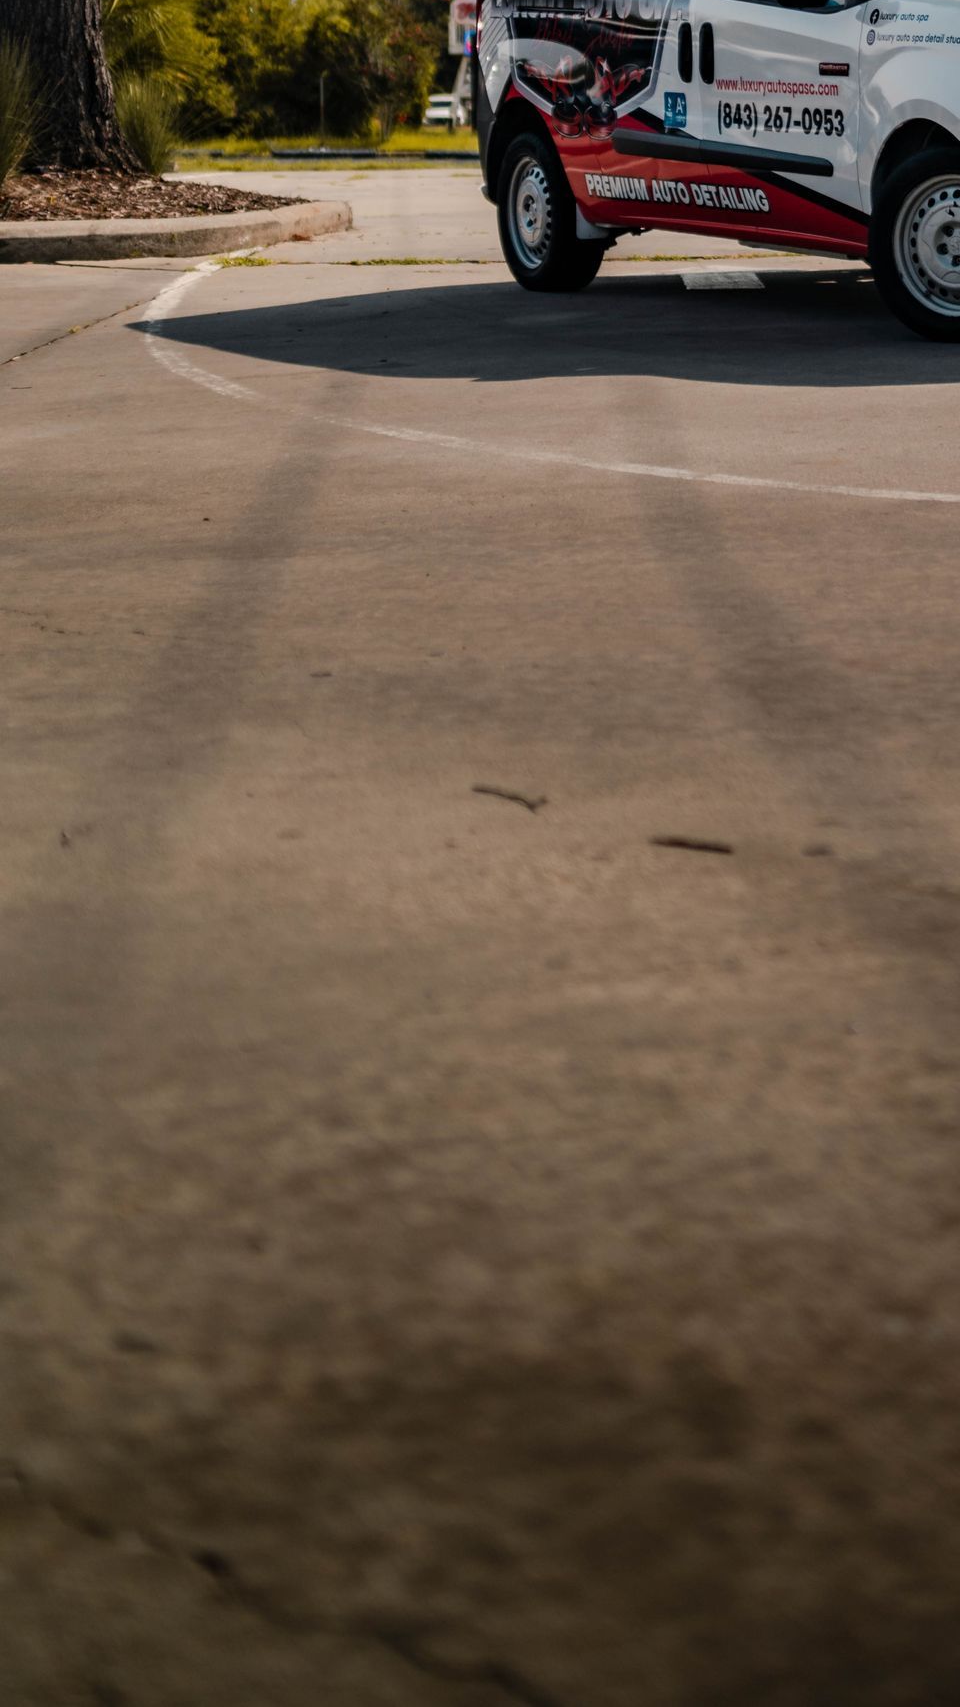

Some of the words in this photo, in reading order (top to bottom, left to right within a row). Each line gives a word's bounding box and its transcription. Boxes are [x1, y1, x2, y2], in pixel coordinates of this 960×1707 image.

[879, 12, 898, 23] luxury
[900, 12, 915, 21] auto
[916, 13, 929, 23] spa
[877, 33, 894, 44] luxury
[896, 34, 910, 43] auto
[911, 35, 924, 44] spa
[925, 34, 944, 43] detail
[715, 76, 839, 97] www.luxuryautospasc.com
[718, 100, 758, 137] (843)
[763, 104, 845, 137] 267-0953
[585, 173, 649, 201] PREMIUM
[651, 179, 690, 205] AUTO
[690, 183, 769, 212] DETAILING
